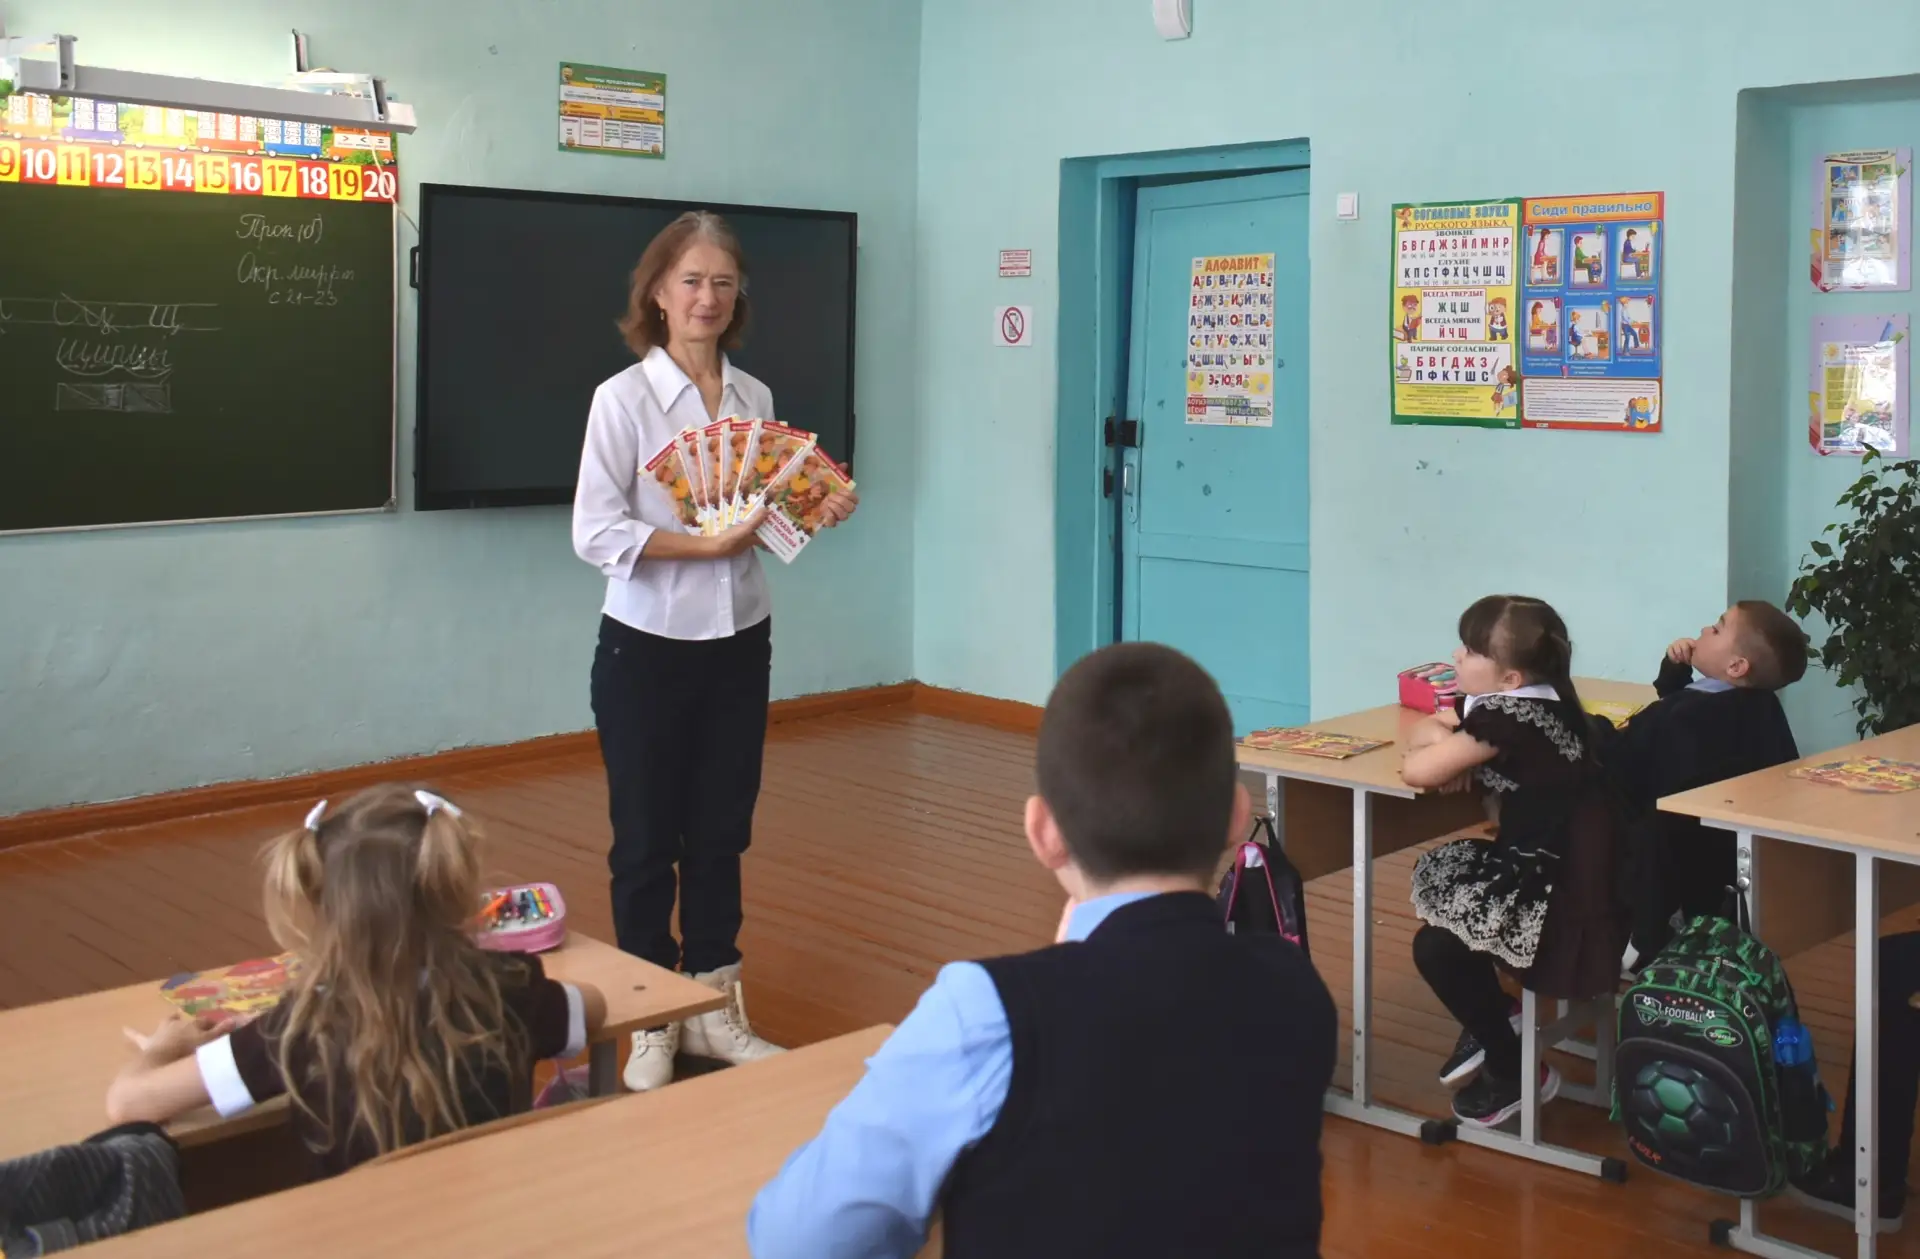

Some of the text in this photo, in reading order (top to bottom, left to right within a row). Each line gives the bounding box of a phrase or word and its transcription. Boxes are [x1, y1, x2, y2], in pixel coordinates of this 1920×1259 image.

[0, 147, 395, 198] 9 10 11 12 13 14 15 16 17 18 19 20
[1532, 202, 1652, 216] Сиди правильно
[1205, 257, 1259, 272] АЛФАВИТ
[1664, 1006, 1704, 1023] FOOTBALL
